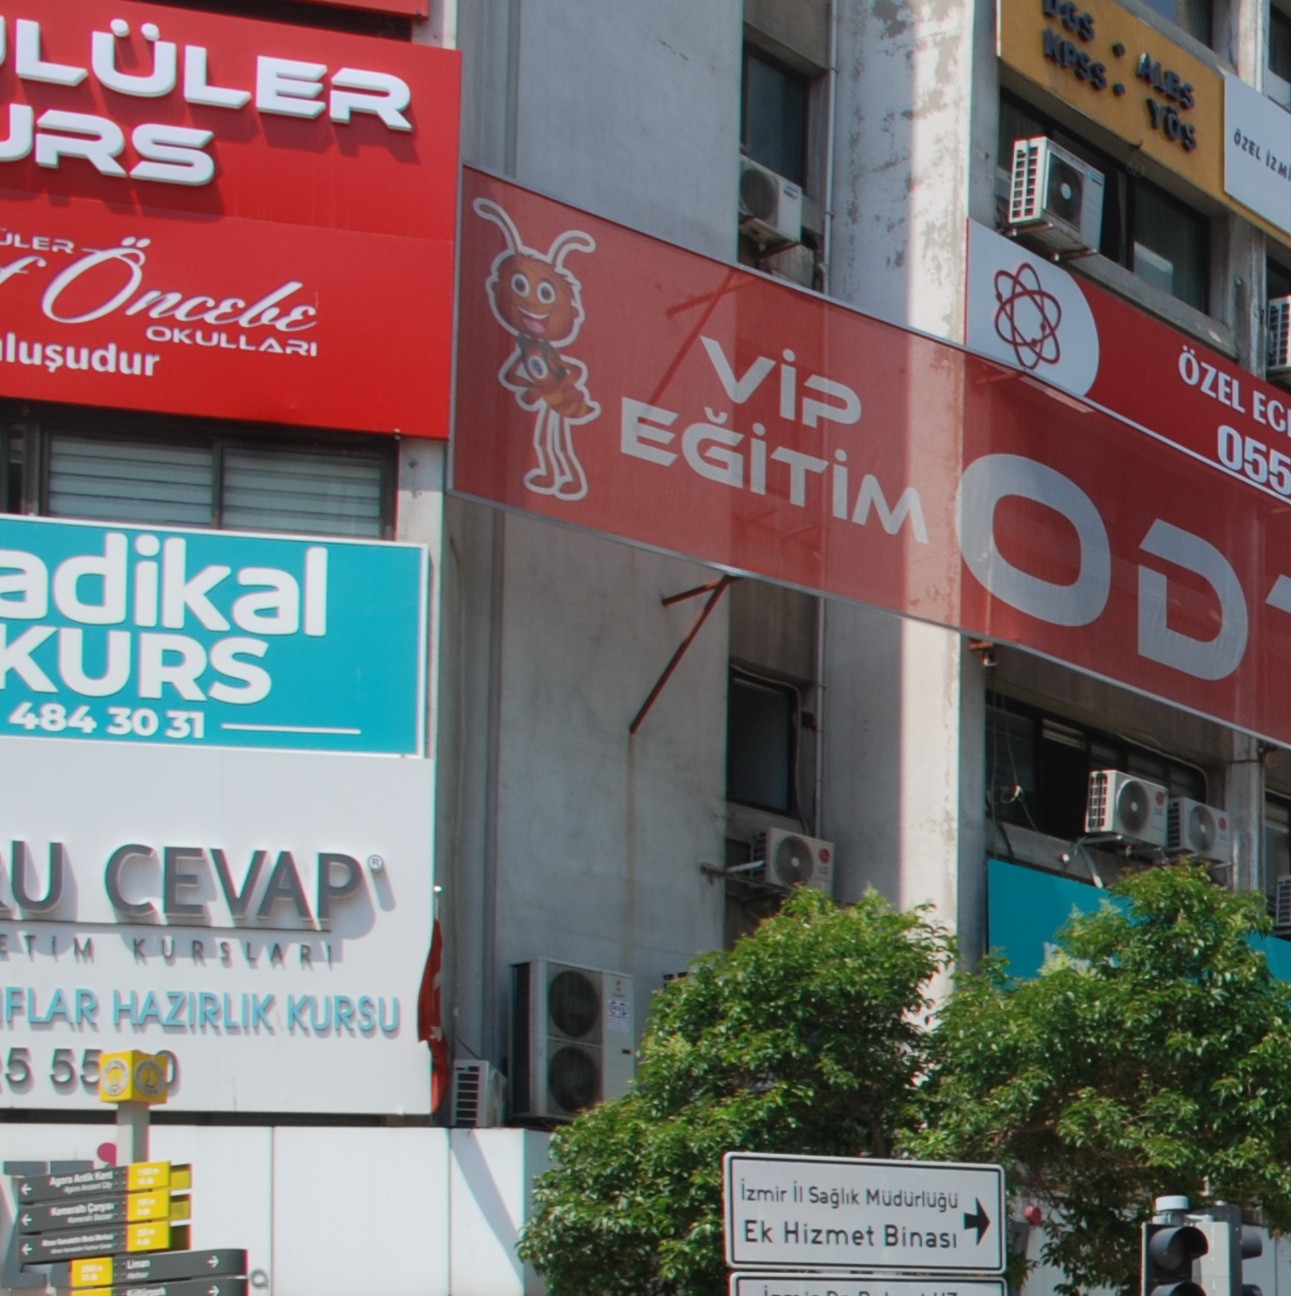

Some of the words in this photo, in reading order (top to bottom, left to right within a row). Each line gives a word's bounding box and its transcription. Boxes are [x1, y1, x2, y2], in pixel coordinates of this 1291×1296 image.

[0, 15, 412, 132] LÜLER
[1042, 28, 1108, 92] KPSS
[1146, 98, 1197, 151] YÖS
[1136, 52, 1195, 110] ALES
[1233, 128, 1261, 159] ÖZEL
[42, 236, 318, 332] Öncebe
[0, 332, 161, 377] luşudur
[145, 326, 318, 357] OKULLARI
[701, 335, 862, 429] VİP
[1178, 344, 1247, 417] ÖZEL
[620, 395, 930, 546] EĞİTİM
[8, 701, 98, 734] 484
[106, 706, 159, 737] 30
[165, 709, 206, 740] 31
[0, 840, 64, 913] U
[104, 843, 365, 932] CEVAP
[133, 937, 336, 971] KURSLARI
[0, 986, 99, 1030] FLAR
[112, 989, 276, 1034] HAZIRLIK
[288, 993, 402, 1034] KURSU
[740, 1178, 788, 1203] İzmir
[793, 1180, 803, 1203] İl
[808, 1186, 861, 1209] Sağlık
[865, 1190, 959, 1214] Müdürlüğü
[744, 1220, 774, 1244] Ek
[783, 1221, 875, 1248] Hizmet
[884, 1225, 959, 1249] Binası
